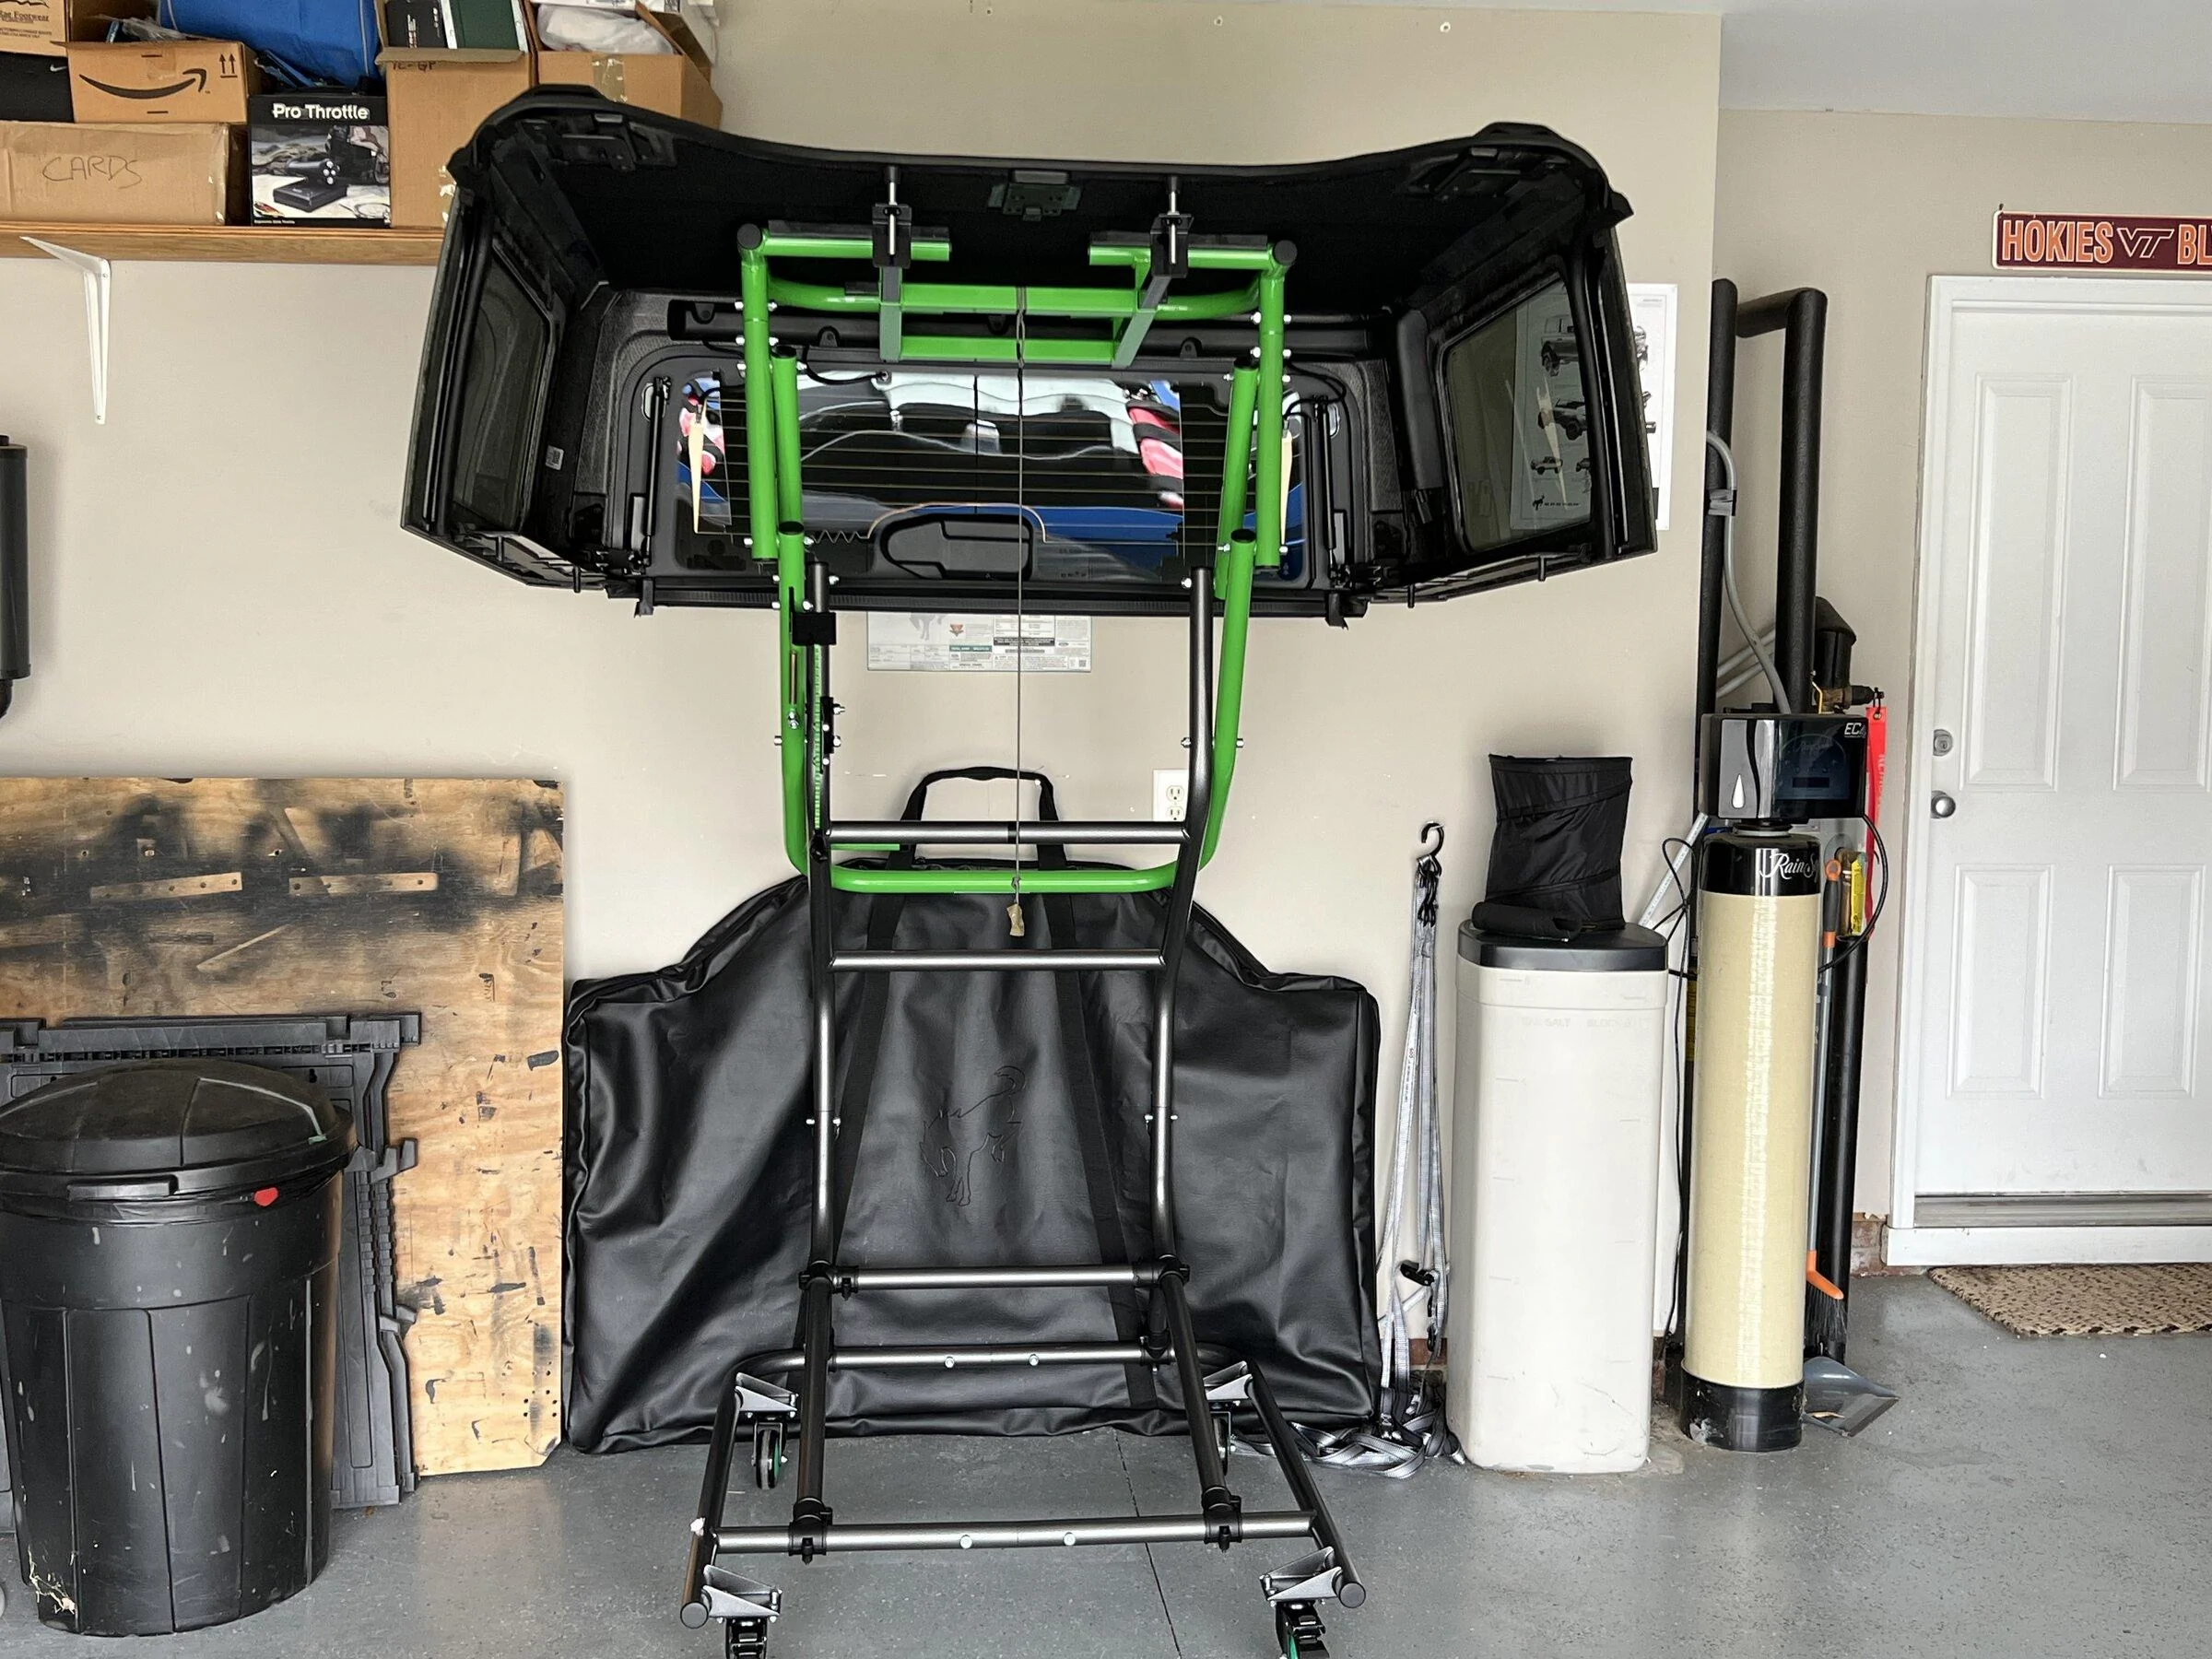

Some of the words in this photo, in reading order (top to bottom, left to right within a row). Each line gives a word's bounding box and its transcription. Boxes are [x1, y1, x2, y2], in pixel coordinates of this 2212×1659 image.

[272, 103, 301, 119] Pro
[305, 103, 370, 120] Throttle
[41, 155, 143, 189] CARDS
[2001, 219, 2114, 264] HOKIES
[2116, 228, 2175, 259] VT
[2177, 224, 2212, 265] BL
